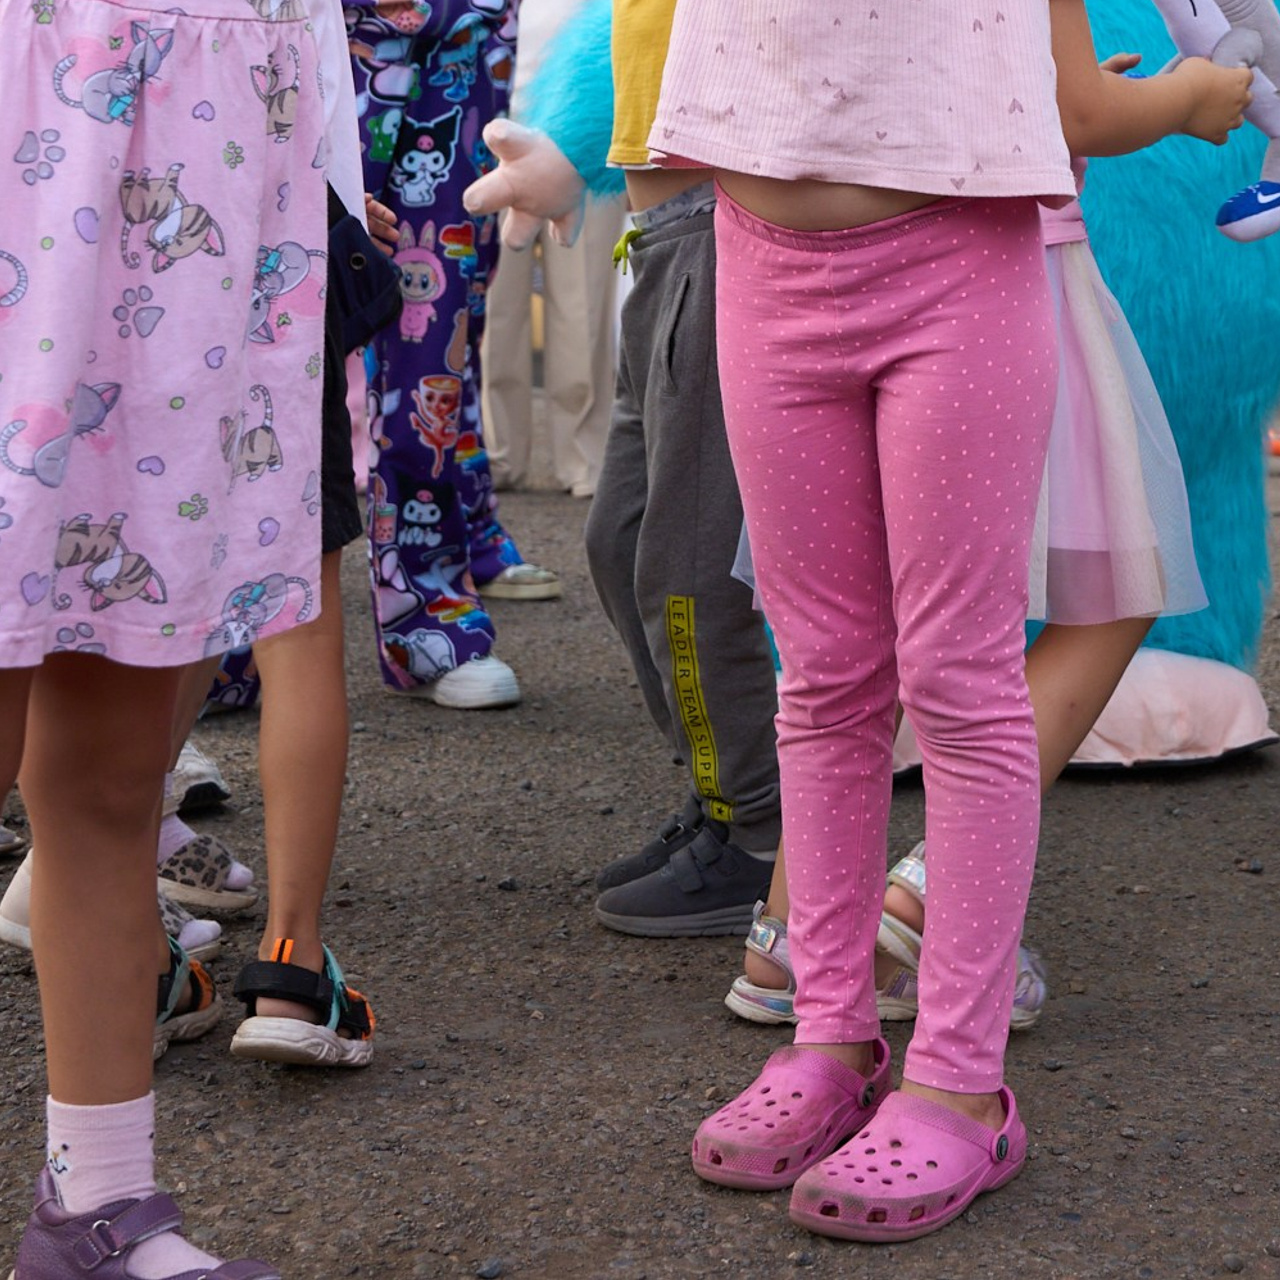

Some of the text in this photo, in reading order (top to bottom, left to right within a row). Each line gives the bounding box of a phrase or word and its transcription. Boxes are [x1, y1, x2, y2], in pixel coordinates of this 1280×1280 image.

[672, 599, 715, 797] LEADER TEAM SUPER
